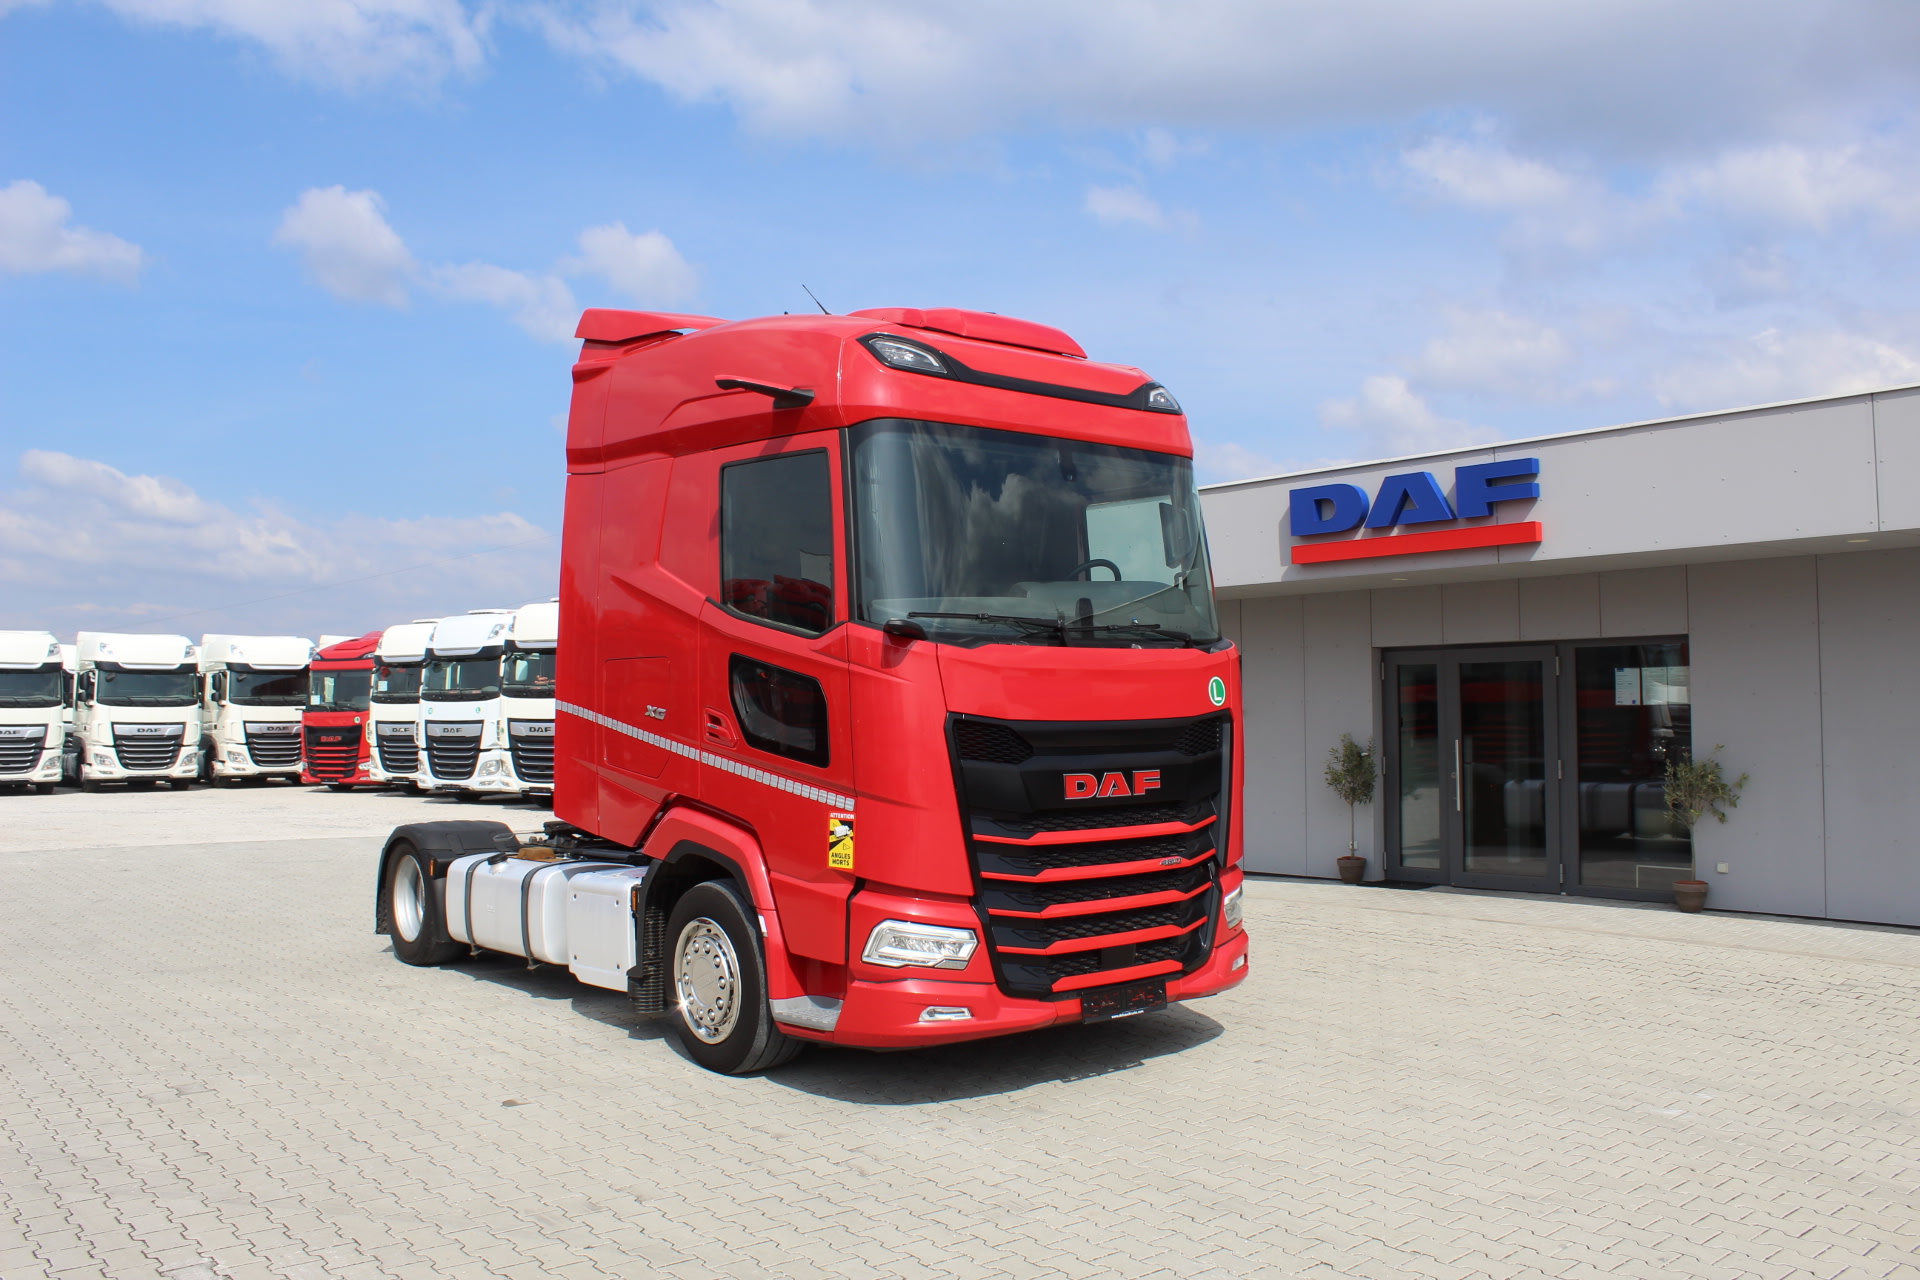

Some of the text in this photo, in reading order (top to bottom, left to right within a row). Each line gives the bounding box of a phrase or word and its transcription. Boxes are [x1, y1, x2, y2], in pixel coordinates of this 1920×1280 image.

[1289, 457, 1540, 537] DAF
[644, 705, 666, 720] XG
[1063, 770, 1161, 800] DAF
[831, 852, 850, 860] ANGLES
